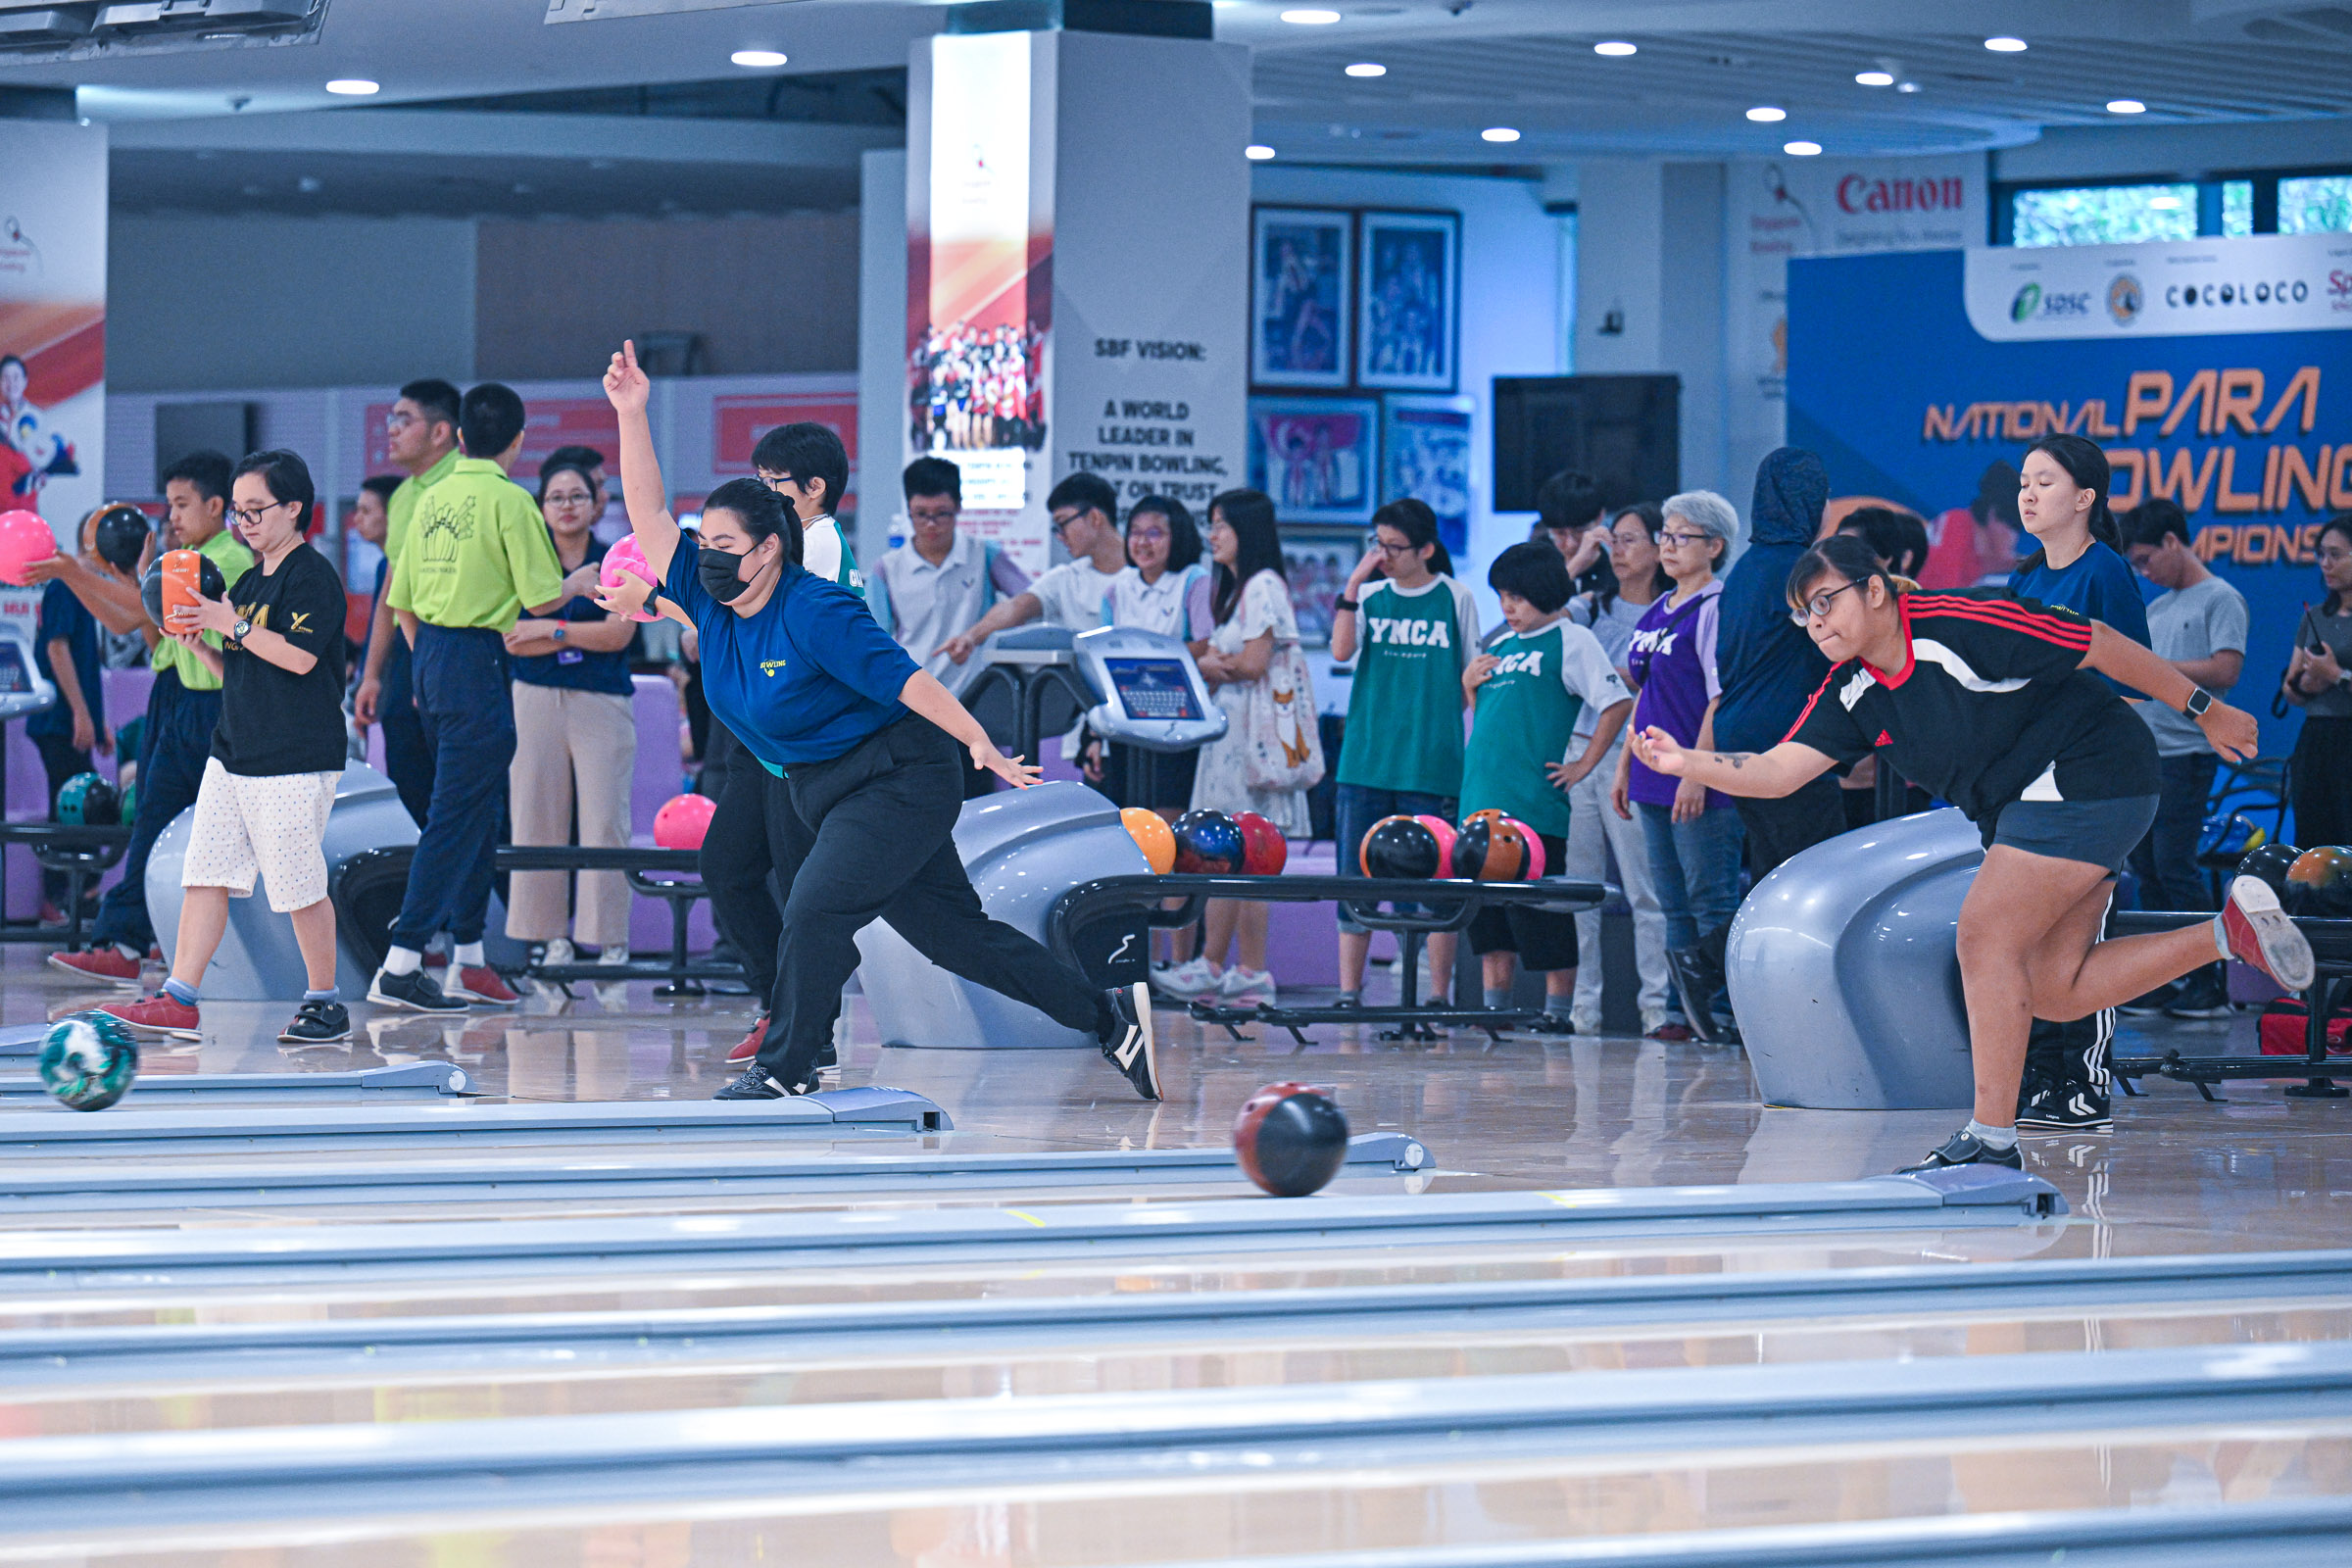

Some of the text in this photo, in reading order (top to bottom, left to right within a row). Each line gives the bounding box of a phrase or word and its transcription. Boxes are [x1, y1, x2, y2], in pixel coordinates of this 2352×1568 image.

[1836, 172, 1963, 215] Canon
[2165, 279, 2309, 308] COCOLOCO
[1095, 338, 1131, 358] SBF
[1103, 399, 1190, 420] A WORLD
[1923, 366, 2322, 440] NATIONAL PARA
[1099, 425, 1195, 447] LEADER IN
[1068, 452, 1228, 477] TENPIN BOWLING,
[2105, 444, 2352, 512] OWLING
[1160, 481, 1219, 501] TRUST
[1369, 617, 1450, 649] YMCA
[1628, 627, 1679, 656] YMA
